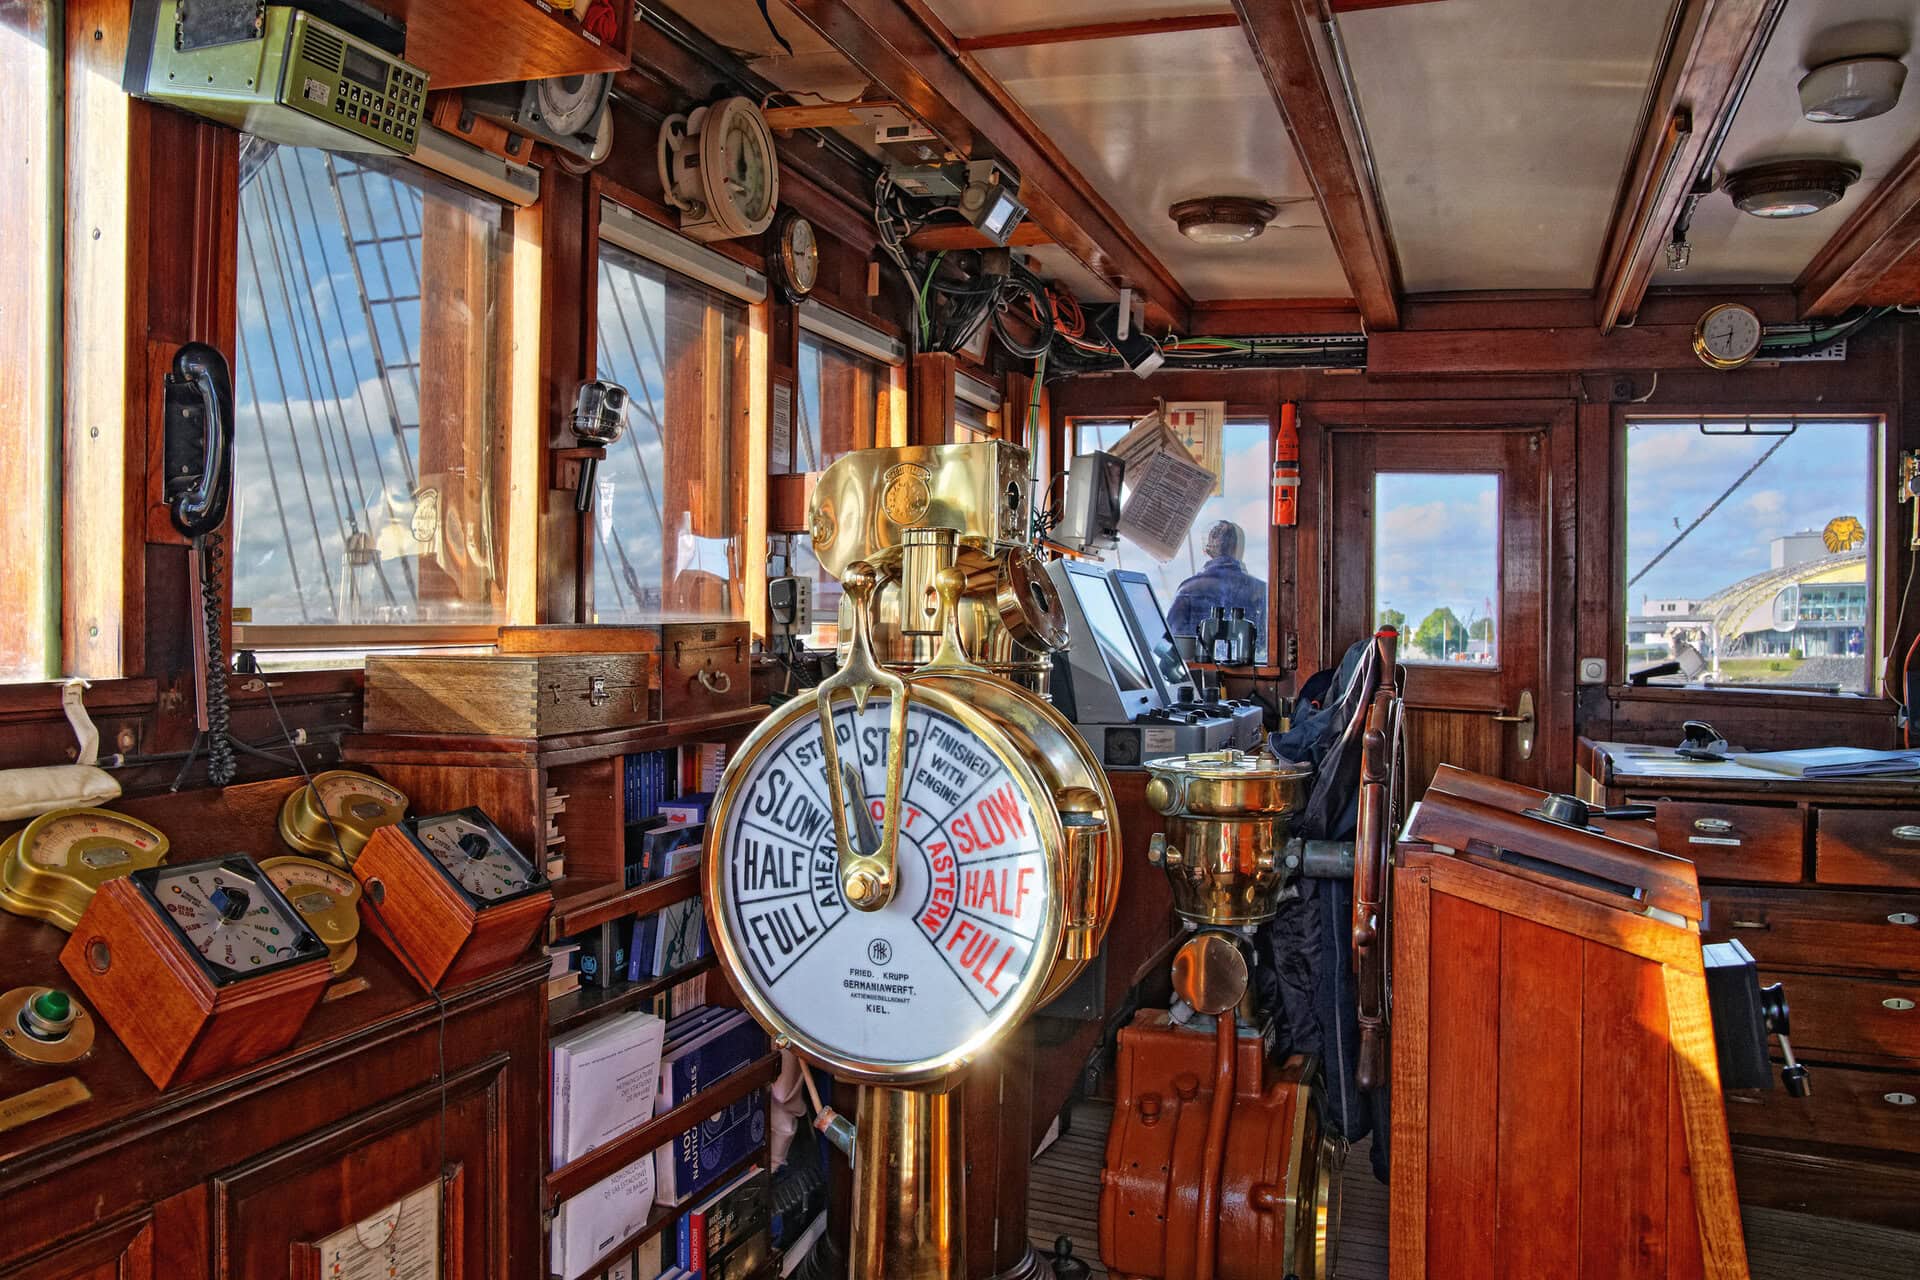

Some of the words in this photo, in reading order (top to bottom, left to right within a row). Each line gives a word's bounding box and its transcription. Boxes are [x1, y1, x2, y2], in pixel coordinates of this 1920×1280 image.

[863, 726, 920, 769] STP
[928, 725, 991, 777] FINISHED
[930, 753, 968, 788] WITH
[755, 768, 825, 841] SLOW
[915, 768, 960, 806] ENGINE
[951, 781, 1027, 854] SLOW
[744, 838, 805, 891] HALF
[921, 841, 955, 934] ASTERN
[964, 867, 1035, 918] HALF
[749, 903, 817, 967] FULL
[945, 920, 1015, 998] FULL
[843, 979, 917, 996] GERMANIAWERFT.
[849, 968, 875, 978] FRIED.
[883, 972, 909, 981] KRUPP
[866, 1004, 890, 1014] KIEL.
